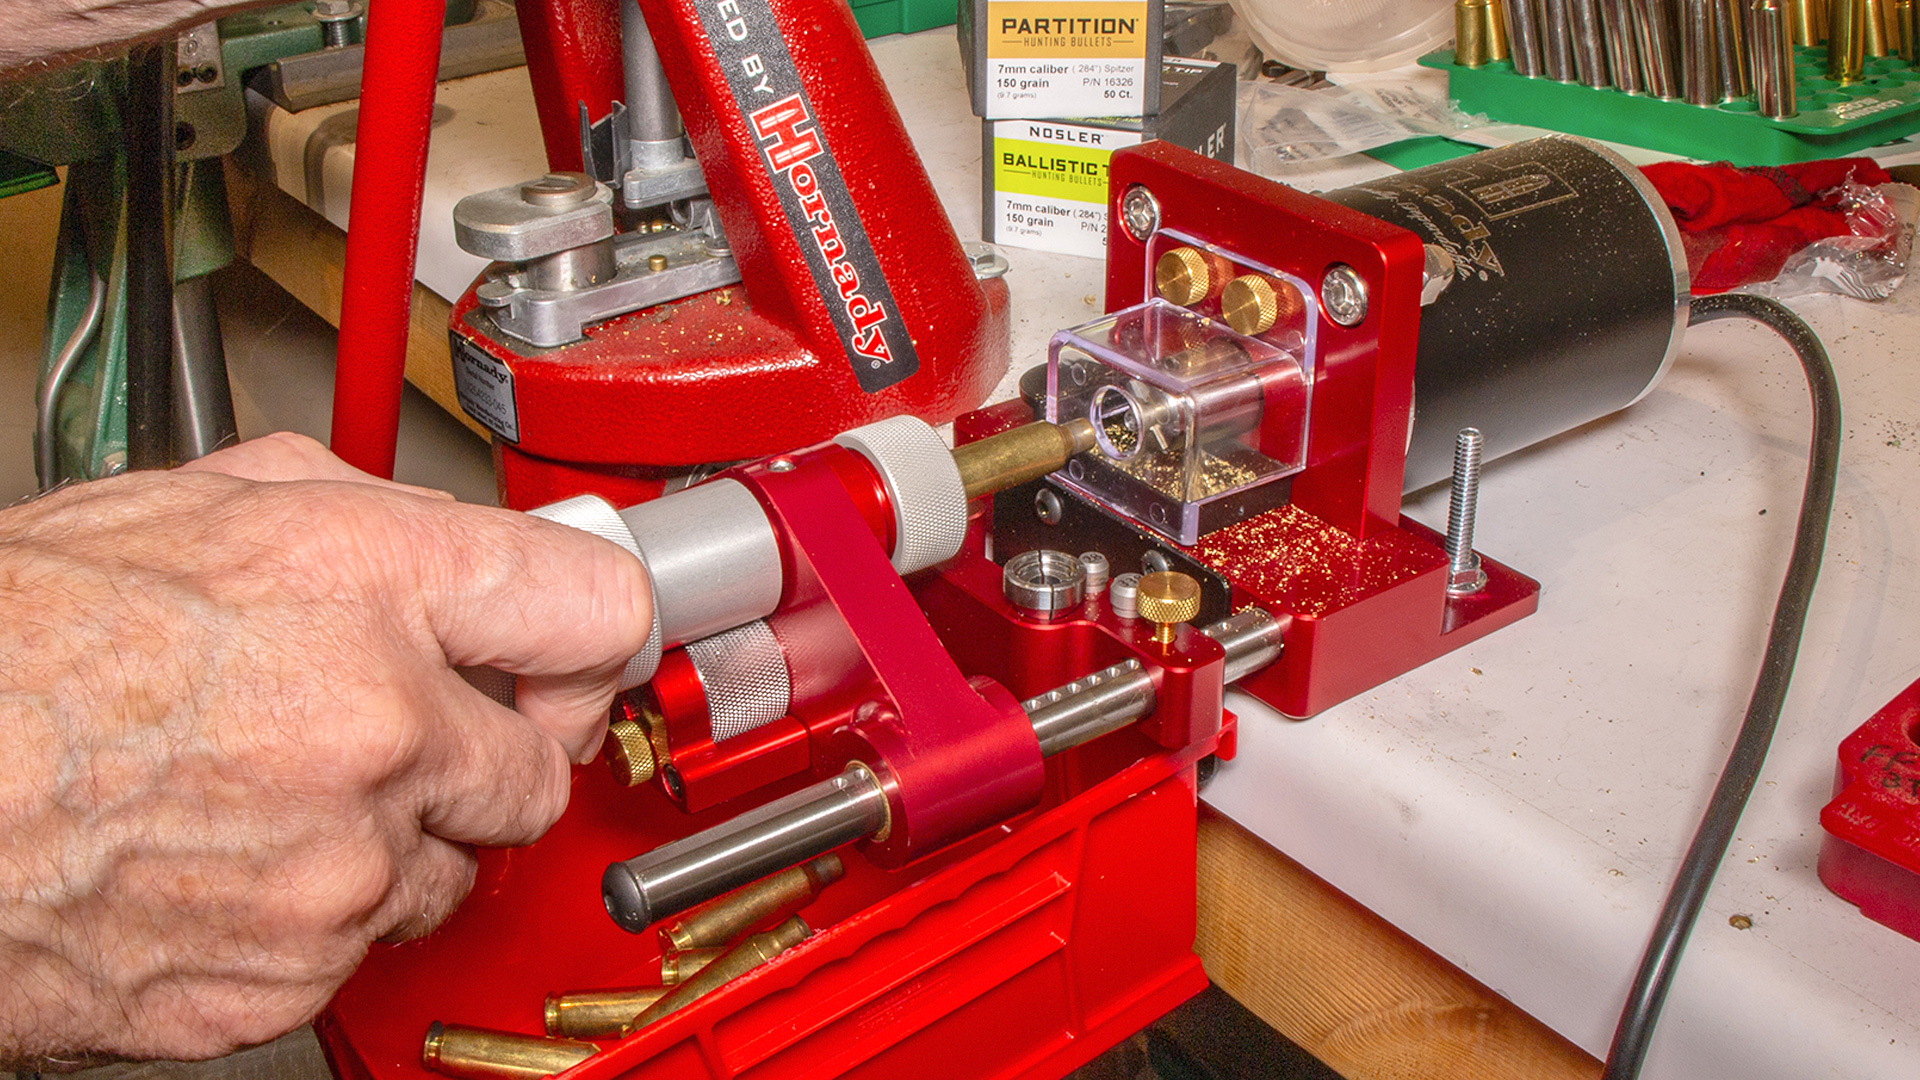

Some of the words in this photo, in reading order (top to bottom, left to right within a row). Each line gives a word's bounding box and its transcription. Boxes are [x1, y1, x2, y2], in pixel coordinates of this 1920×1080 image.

[1002, 18, 1135, 34] PARTITION
[1024, 37, 1066, 47] HUNTING
[1071, 37, 1112, 47] BULLETS
[742, 53, 774, 94] BY
[998, 64, 1027, 74] 7mm
[1029, 64, 1069, 74] caliber
[1104, 65, 1134, 75] Spitzer
[997, 79, 1016, 88] 150
[1020, 78, 1049, 90] grain
[1083, 78, 1101, 87] P/N
[1104, 78, 1133, 87] 16326
[1104, 90, 1115, 99] 50
[1118, 90, 1133, 99] Ct.
[1029, 126, 1102, 145] NOSLER
[1003, 152, 1098, 176] BALLISTIC
[1032, 170, 1065, 182] HUNTING
[1069, 175, 1102, 187] BULLETS
[1006, 200, 1032, 212] 7mm
[1035, 204, 1071, 217] caliber
[1006, 213, 1024, 223] 150
[1027, 215, 1054, 228] grain
[1081, 222, 1098, 233] P/N
